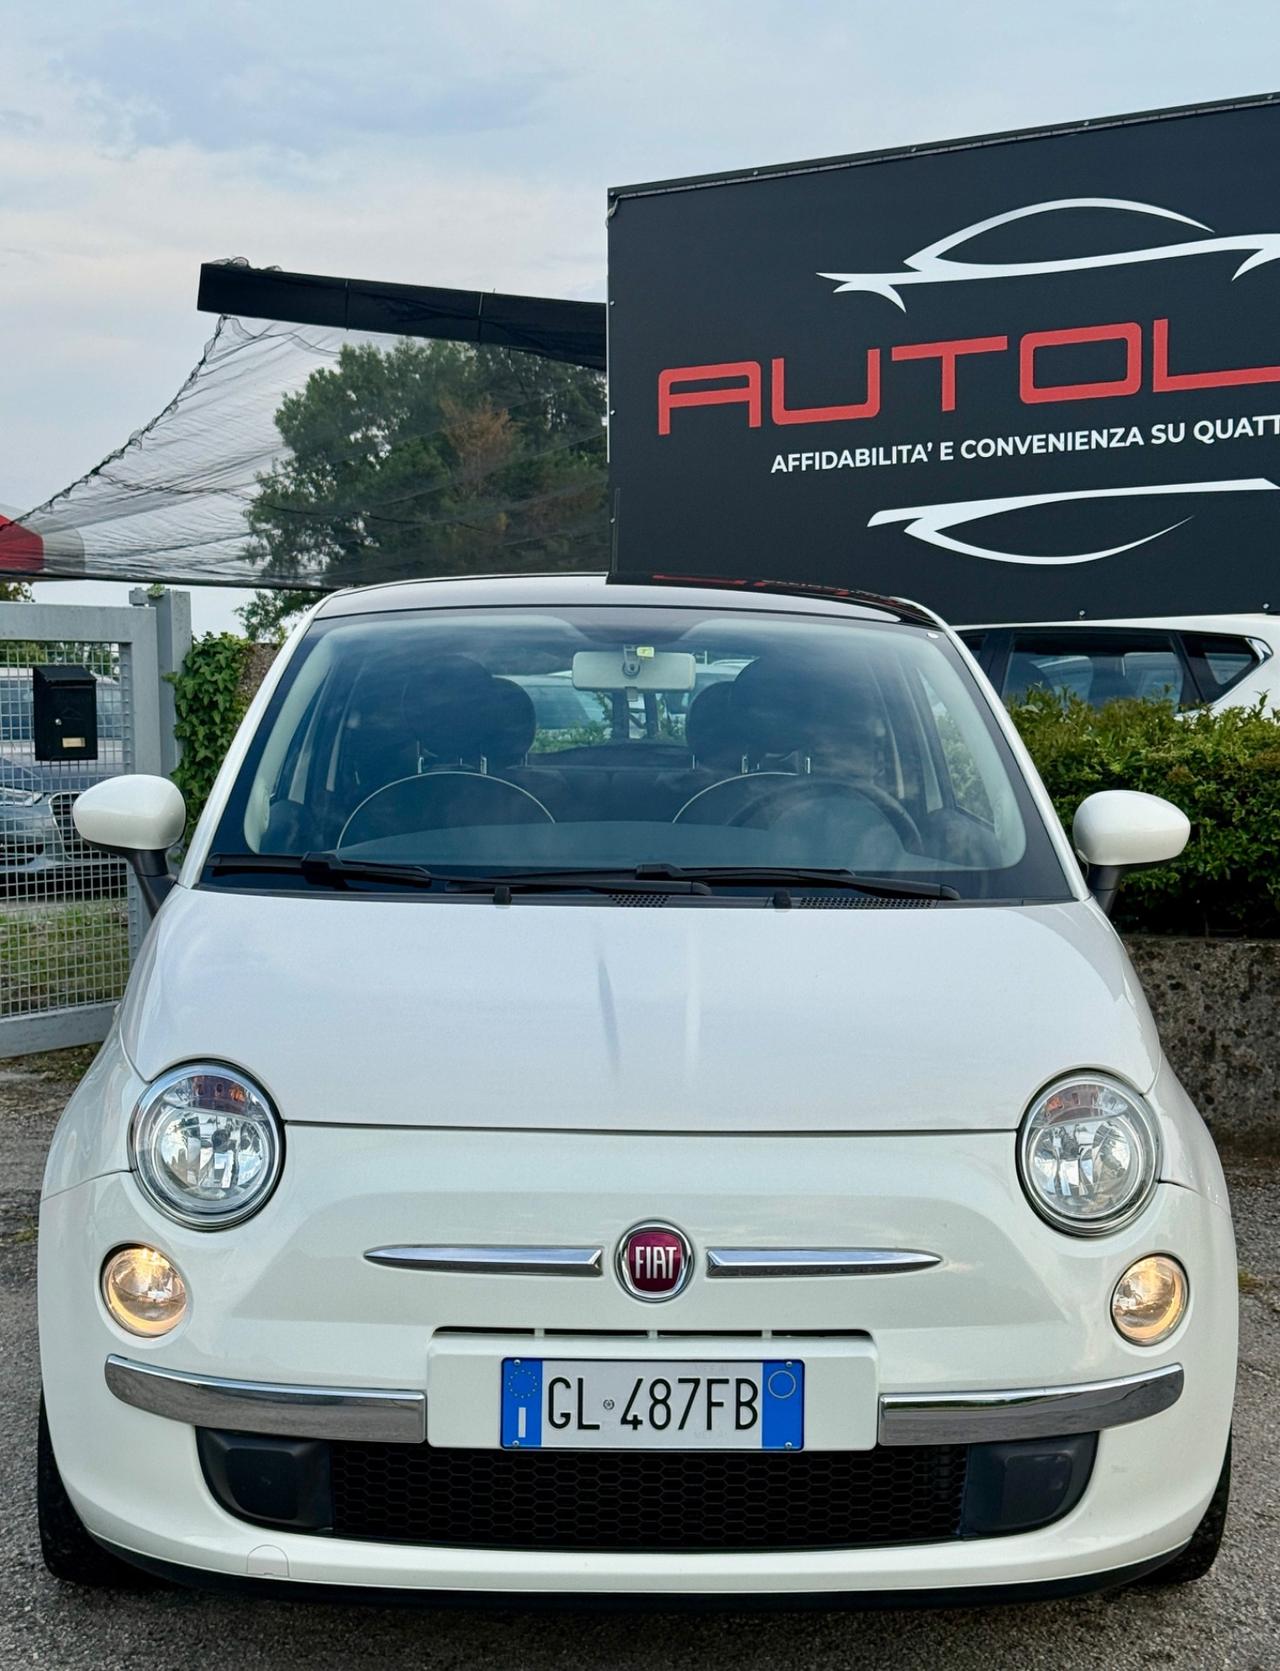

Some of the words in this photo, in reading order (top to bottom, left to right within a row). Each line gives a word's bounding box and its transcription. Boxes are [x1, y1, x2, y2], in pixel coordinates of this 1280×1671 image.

[657, 317, 1280, 436] AUTOL
[939, 441, 955, 461] E
[960, 426, 1145, 459] CONVENIENZA
[1150, 422, 1186, 445] SU
[634, 1246, 677, 1279] FIAT
[548, 1377, 600, 1430] GL
[619, 1377, 759, 1431] 487FB
